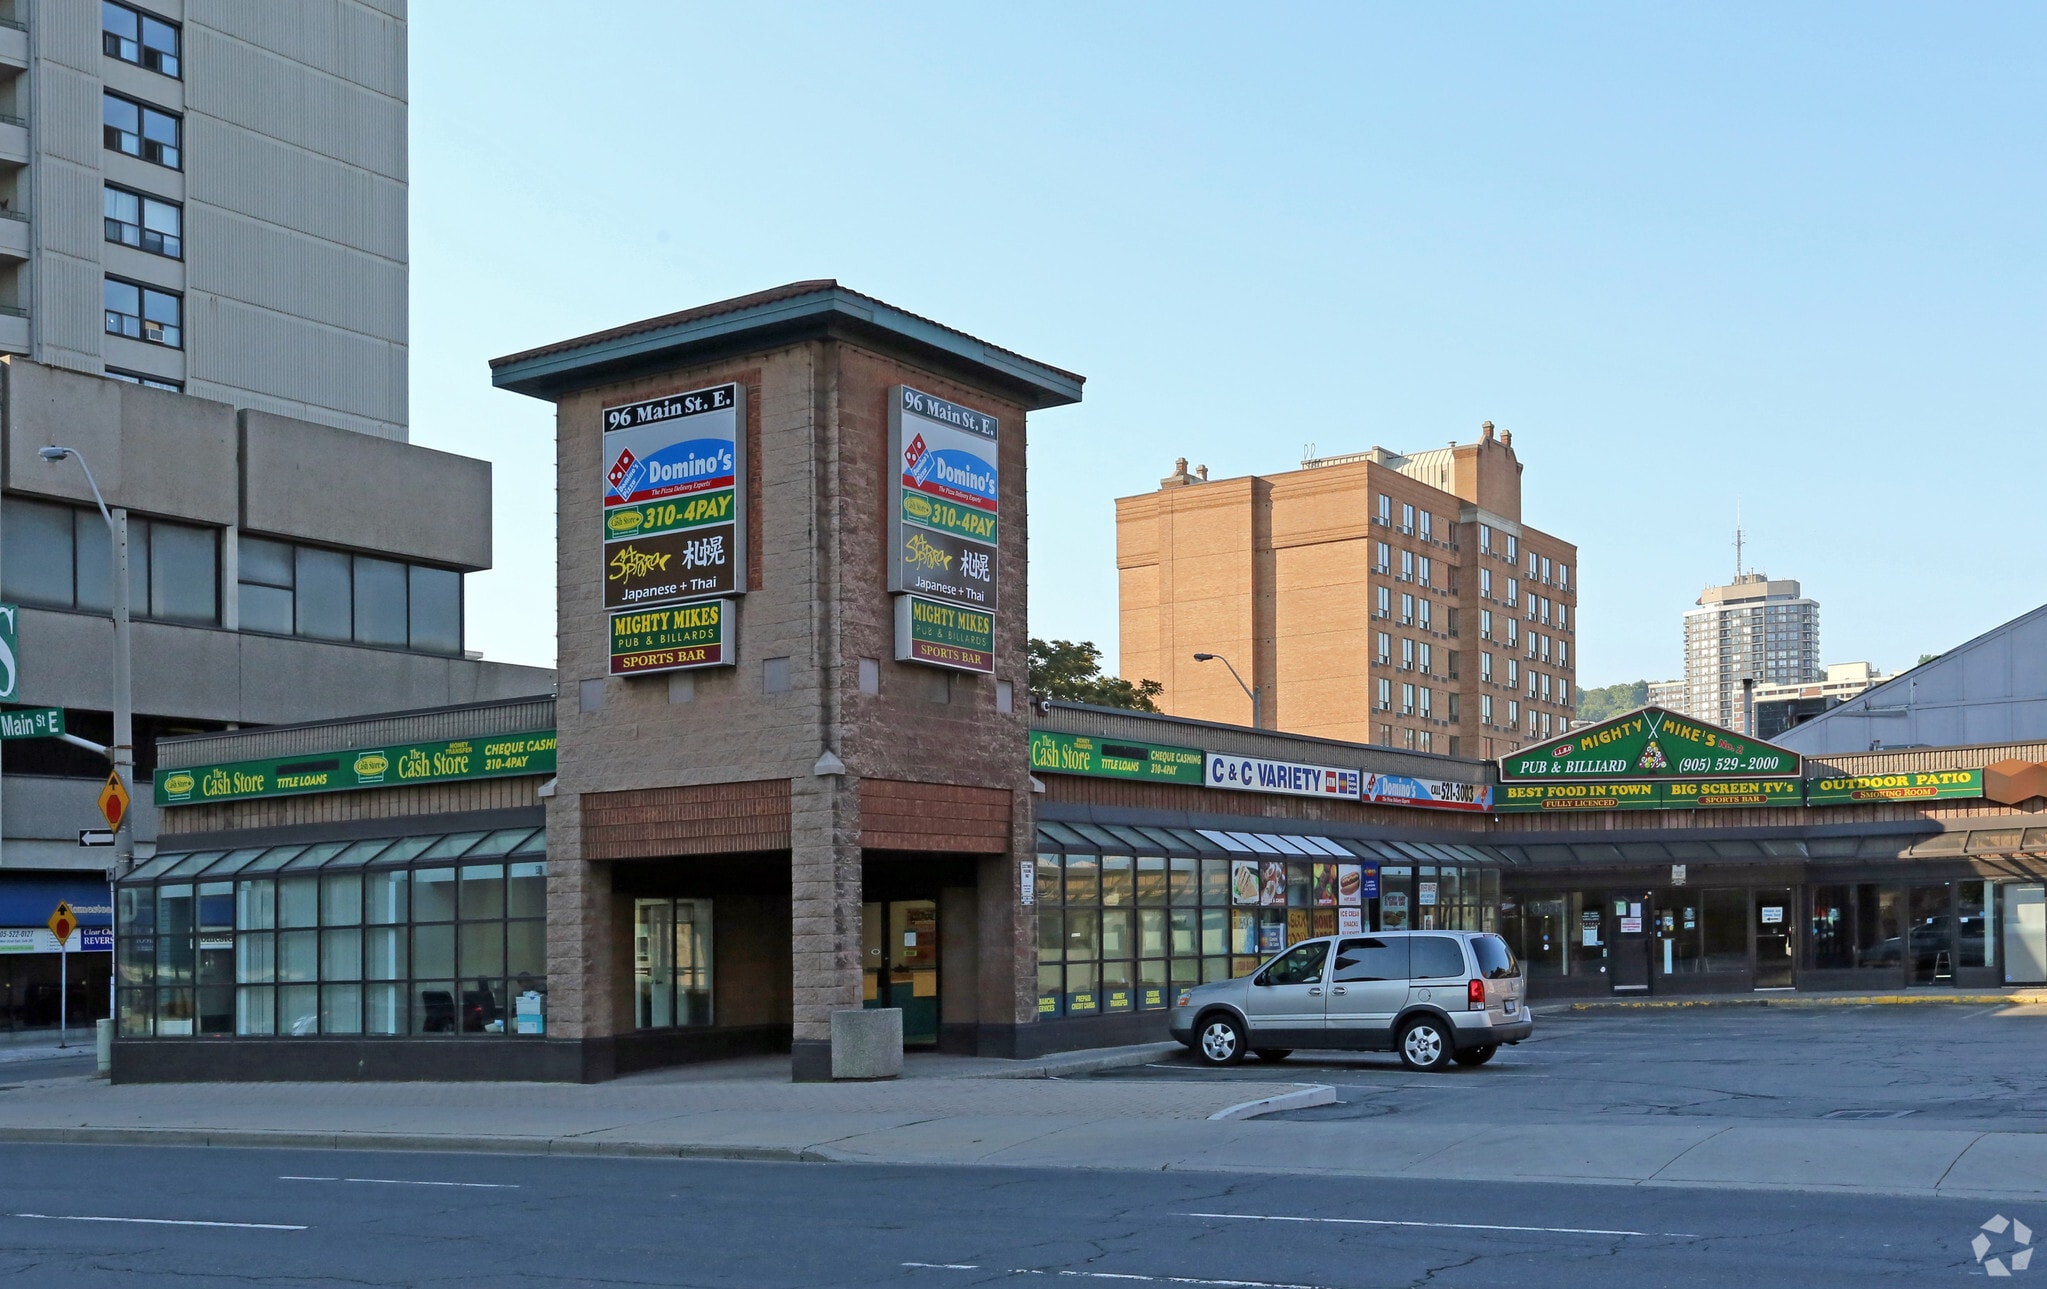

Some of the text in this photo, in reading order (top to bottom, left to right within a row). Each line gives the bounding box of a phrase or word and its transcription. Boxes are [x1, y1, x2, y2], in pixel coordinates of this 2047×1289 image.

[609, 390, 731, 430] 96 Main St. E.
[905, 391, 994, 436] 96 Main St. E.
[649, 448, 732, 483] Domino's
[937, 457, 995, 495] Domino's
[618, 464, 639, 493] Domino's
[644, 495, 732, 529] 310-4PAY
[932, 504, 995, 537] 310-4PAY
[682, 536, 725, 570] 札幌
[960, 549, 990, 582] 札幌
[622, 583, 677, 602] Japanese
[690, 576, 717, 591] Thai
[915, 576, 957, 595] Japanese
[966, 588, 984, 602] Thai
[615, 606, 719, 636] MIGHTY MIKES
[913, 602, 990, 635] MIGHTY MIKES
[618, 629, 714, 648] PUB & BILLARDS
[916, 624, 986, 647] PUB & BILLARDS
[623, 650, 706, 668] SPORTS BAR
[921, 644, 981, 665] SPORTS BAR
[1, 711, 59, 736] Main St E
[485, 742, 524, 756] CHEQUE
[1581, 719, 1744, 755] MIGHTY MIKE'S No. 2
[398, 749, 469, 779] The Cash Store
[485, 756, 529, 771] 310-4PAY
[1032, 735, 1090, 771] The Cash Store
[1102, 759, 1140, 772] TITLE LOANS
[1151, 750, 1201, 765] CHEQUE CASHING
[1679, 757, 1711, 773] (905)
[1151, 763, 1177, 775] 310-4PAY
[1212, 758, 1224, 783] C
[1228, 763, 1237, 781] &
[1241, 761, 1252, 785] C
[1257, 763, 1321, 791] VARIETY
[1520, 759, 1627, 774] PUB & BILLIARD
[203, 769, 264, 796] The Cash Store
[277, 774, 327, 789] TITLE LOANS
[1383, 777, 1416, 798] Domino's
[1431, 782, 1474, 802] CALL 521-3003
[1508, 784, 1652, 798] BEST FOOD IN TOWN
[1671, 782, 1794, 795] BIG SCREEN TV's
[1820, 772, 1972, 791] OUTDOOR PATIO
[1546, 799, 1615, 808] FULLY LICENCED
